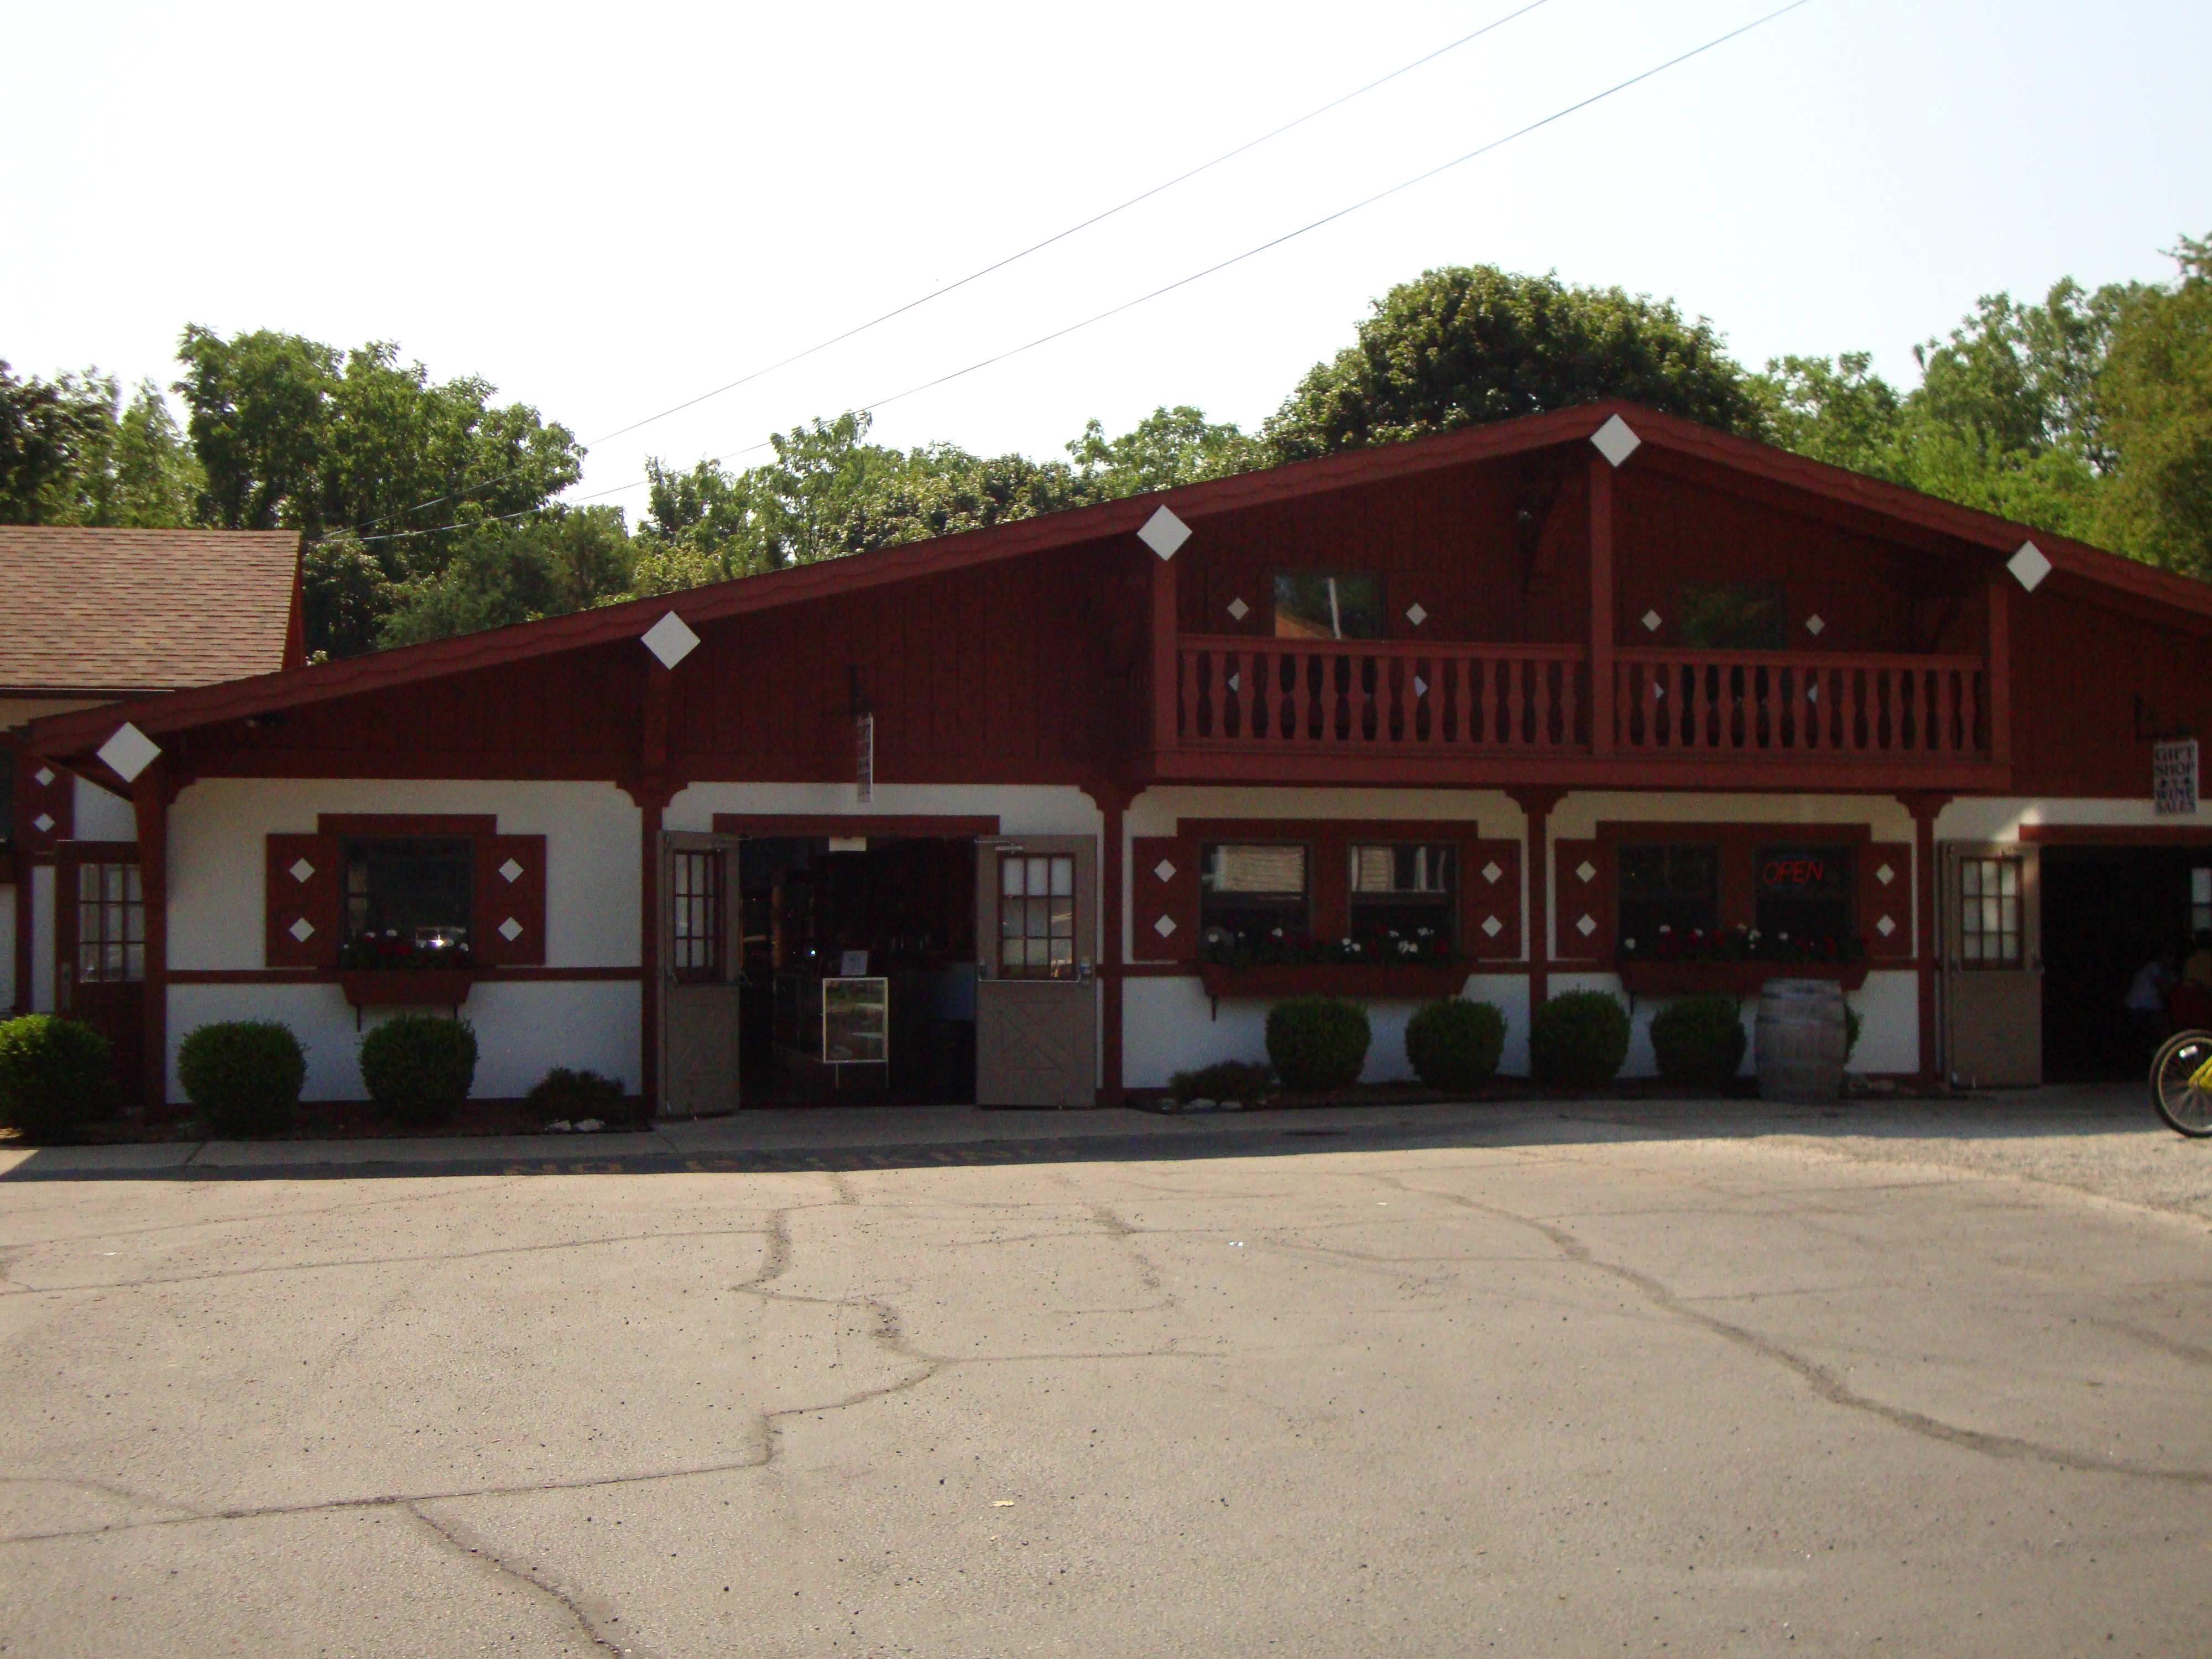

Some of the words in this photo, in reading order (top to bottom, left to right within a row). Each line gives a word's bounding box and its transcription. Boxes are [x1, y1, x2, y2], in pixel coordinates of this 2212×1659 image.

[2155, 747, 2193, 761] GIFT
[2155, 761, 2195, 775] SHOP
[1763, 861, 1823, 883] OPEN
